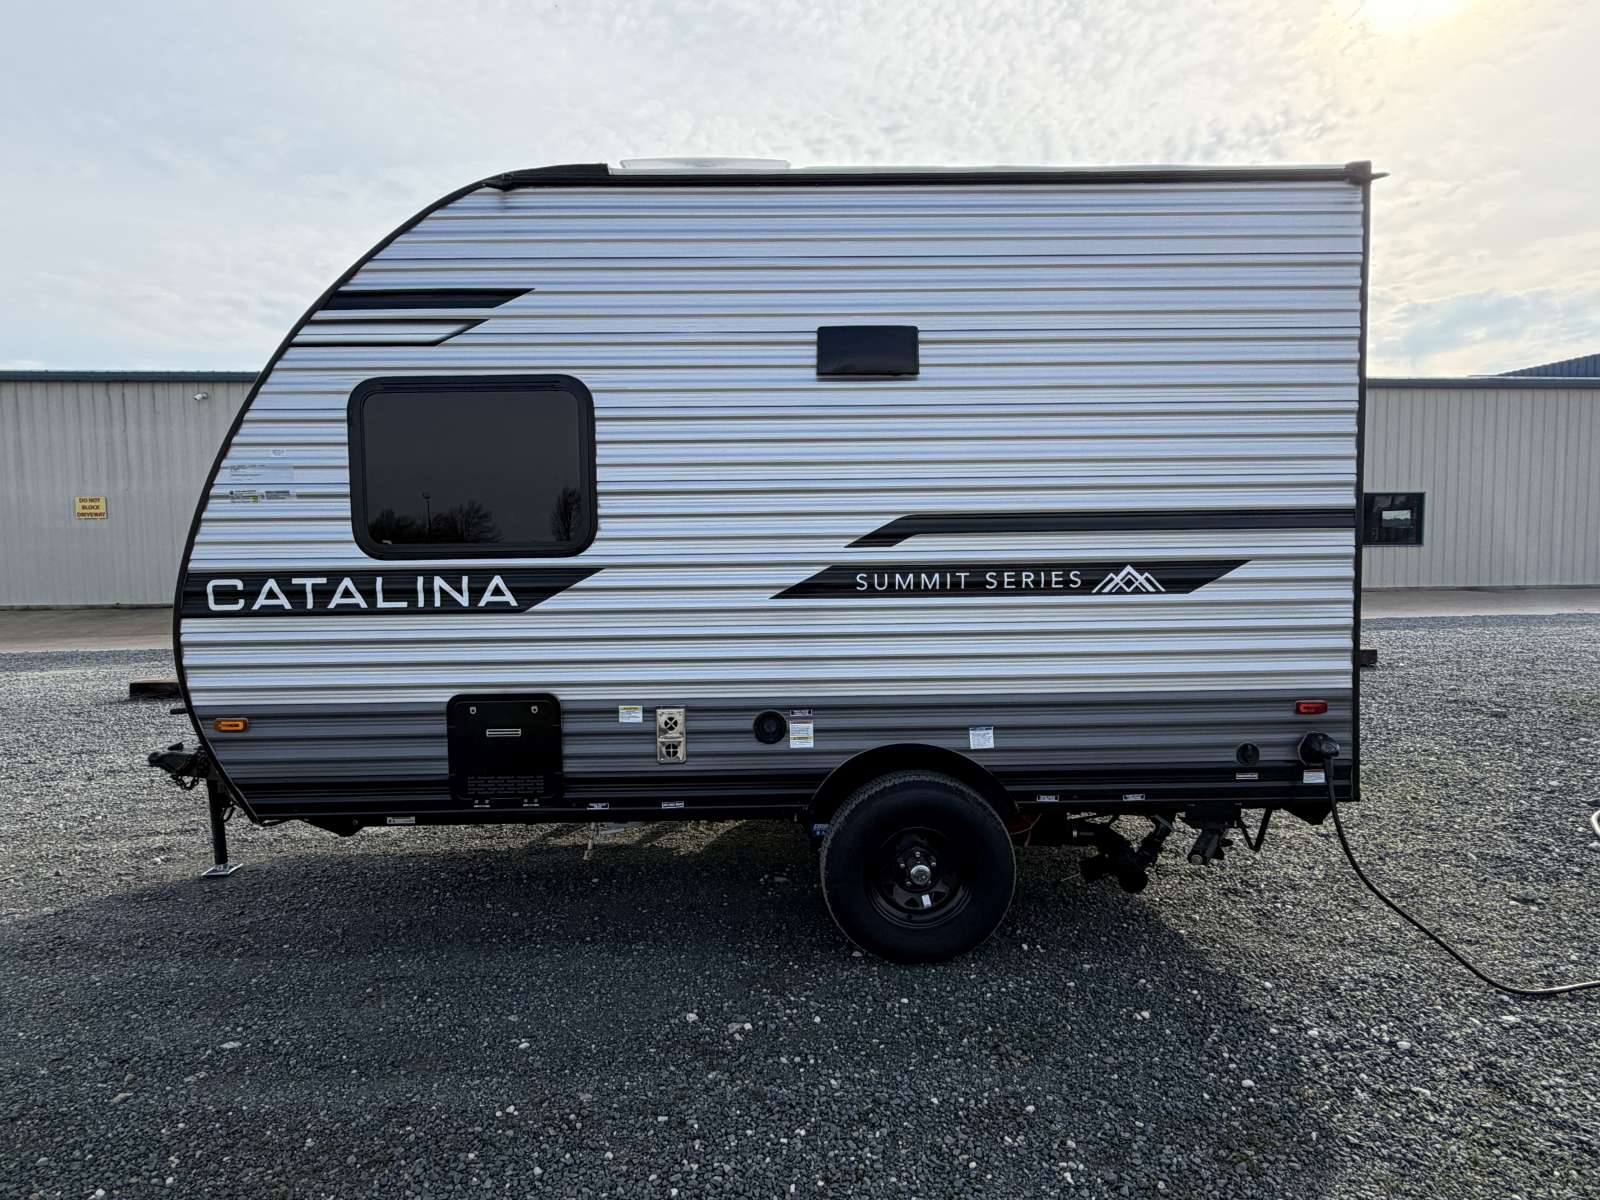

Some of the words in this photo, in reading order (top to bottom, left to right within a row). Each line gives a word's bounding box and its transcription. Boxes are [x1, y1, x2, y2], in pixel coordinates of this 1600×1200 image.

[206, 574, 518, 611] CATALINA
[856, 572, 970, 591] SUMMIT
[985, 570, 1082, 590] SERIES
